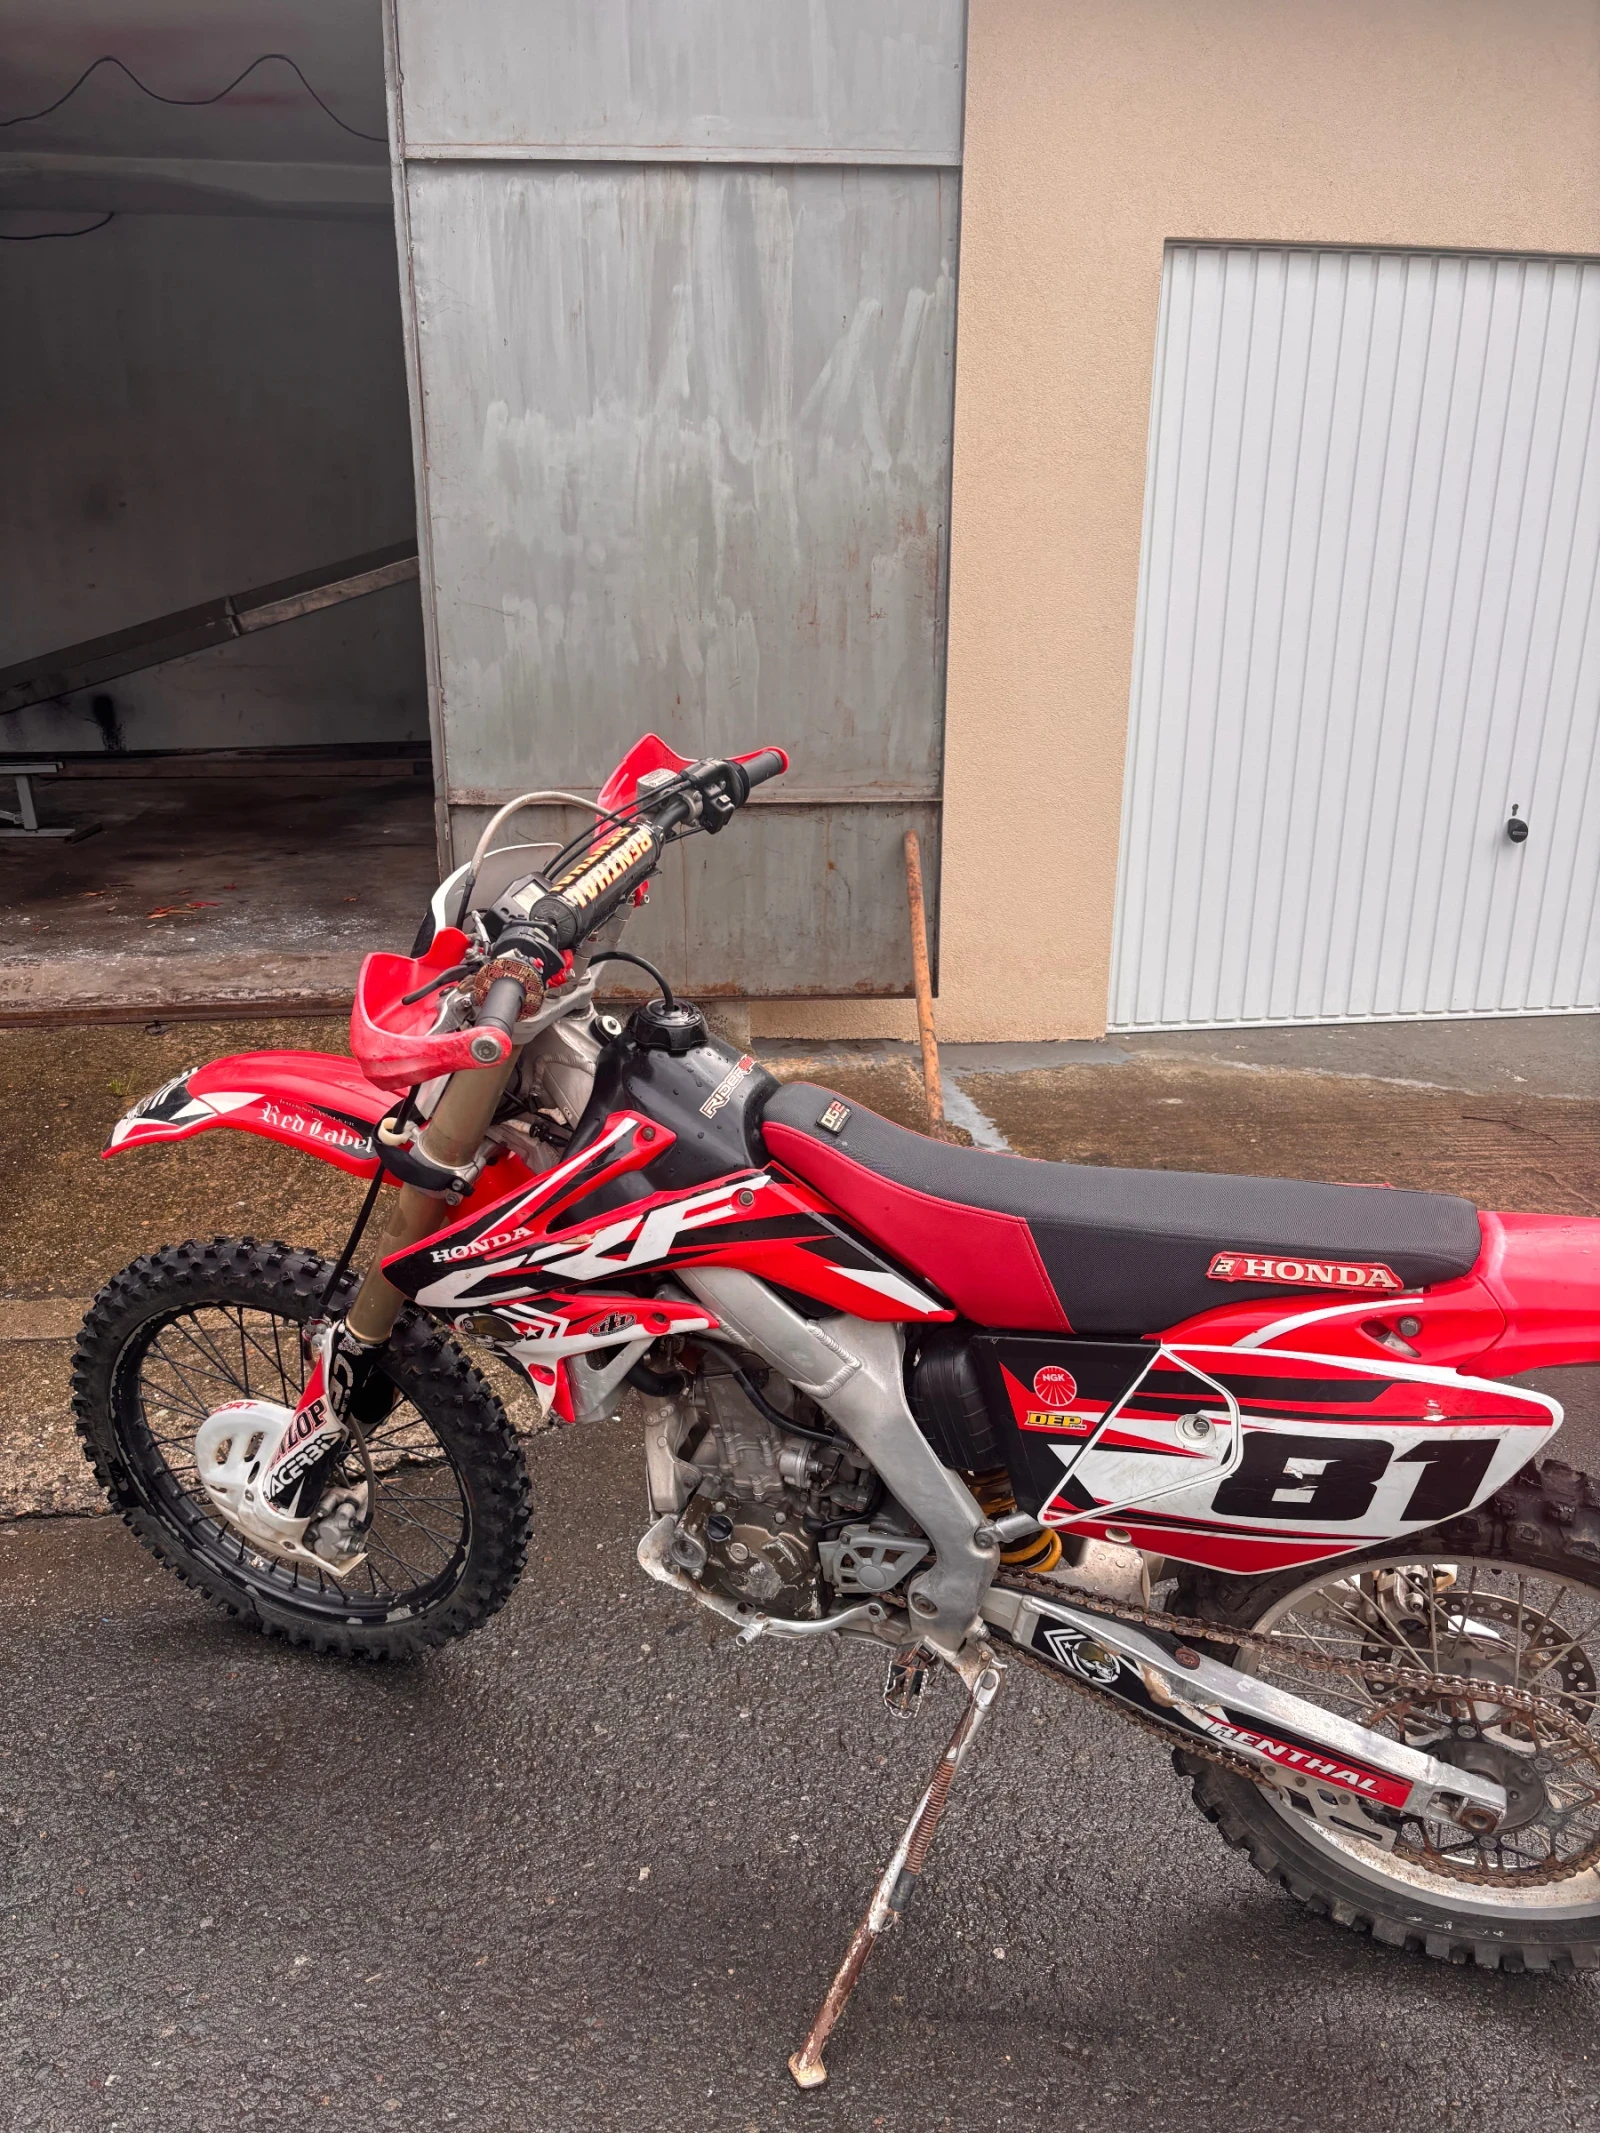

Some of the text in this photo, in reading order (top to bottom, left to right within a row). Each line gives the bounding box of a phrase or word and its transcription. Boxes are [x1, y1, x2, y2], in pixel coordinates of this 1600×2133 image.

[562, 827, 653, 909] RENTHAL
[258, 1101, 374, 1154] Red Label
[415, 1175, 771, 1307] CRF
[432, 1227, 534, 1263] HONDA
[1244, 1258, 1398, 1289] HONDA
[1042, 1373, 1065, 1382] NGK
[1027, 1412, 1082, 1428] DEP
[1211, 1431, 1501, 1521] 81
[1205, 1721, 1381, 1794] RENTHAL
